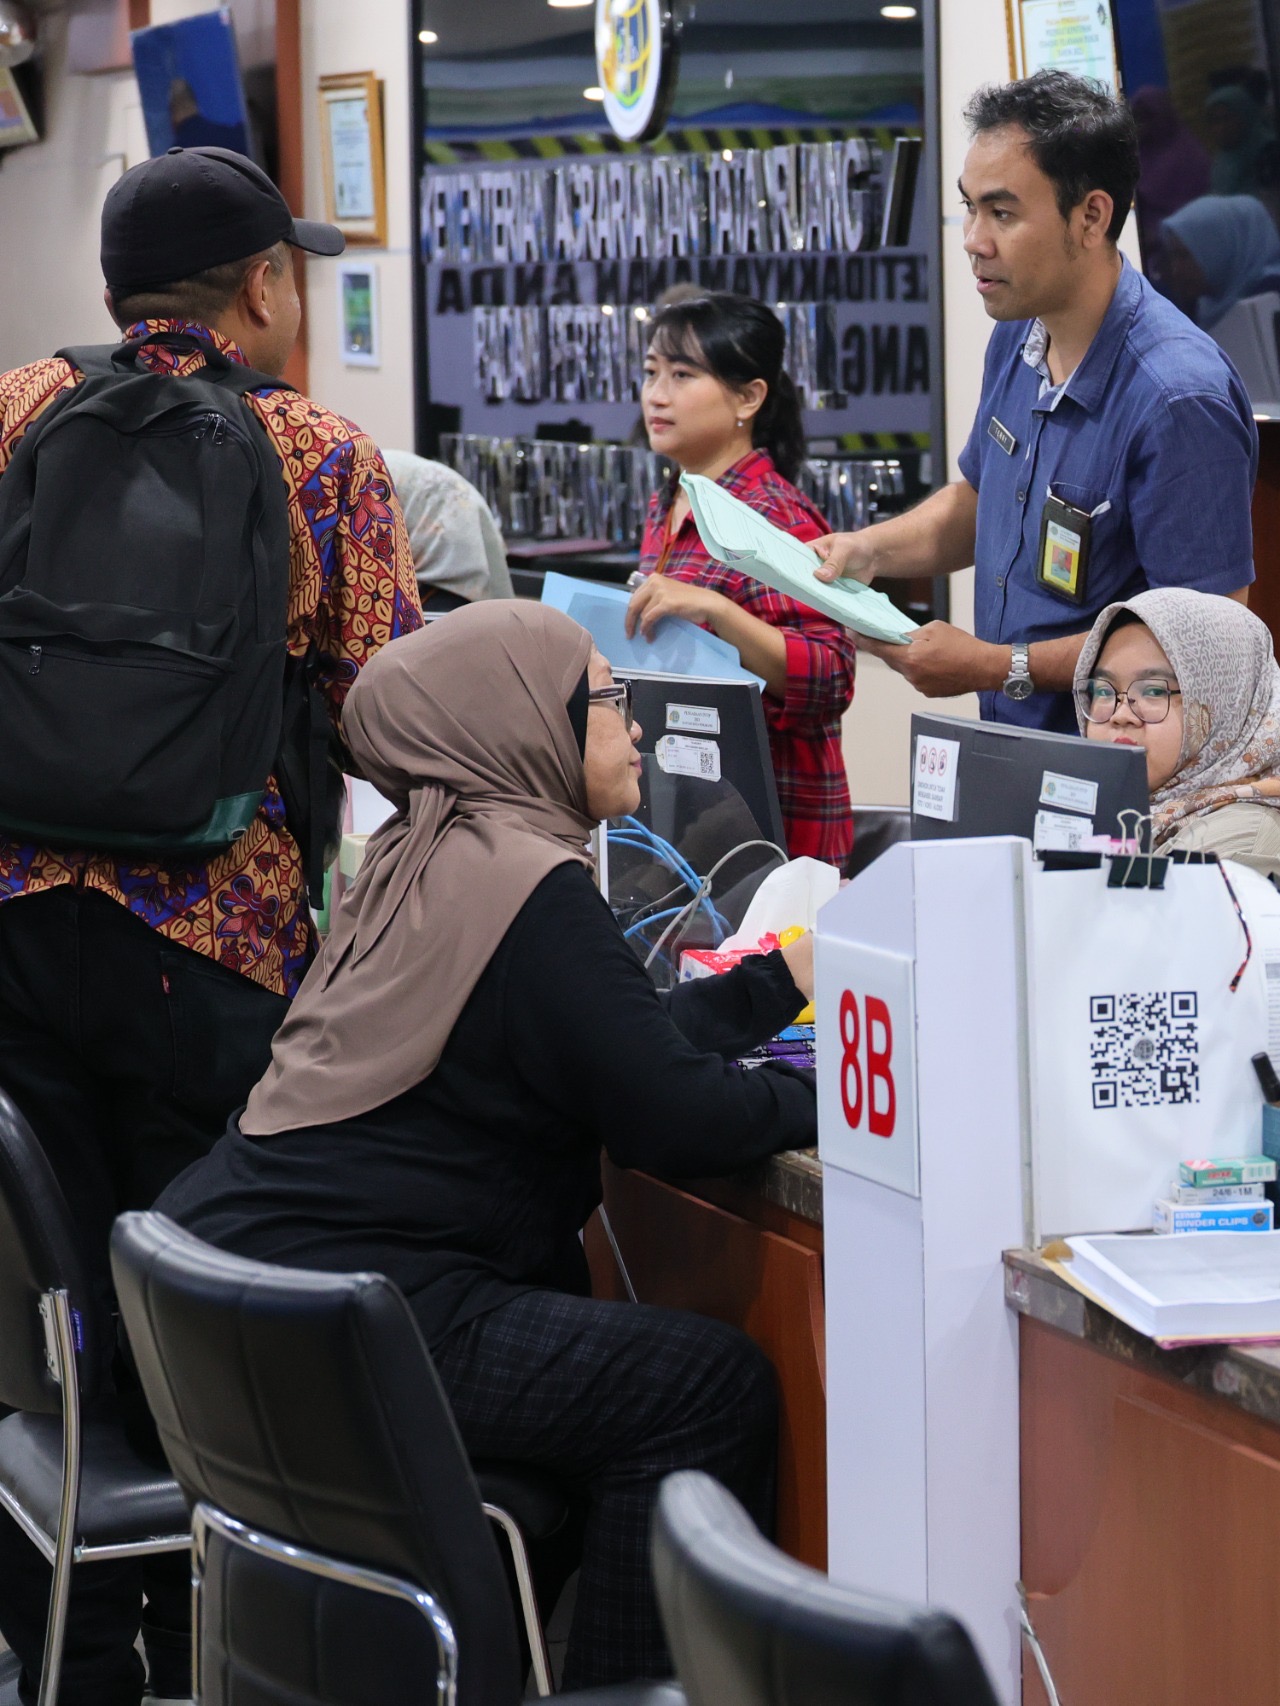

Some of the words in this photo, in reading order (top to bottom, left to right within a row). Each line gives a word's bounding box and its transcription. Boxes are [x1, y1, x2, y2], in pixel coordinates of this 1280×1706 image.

[839, 989, 896, 1138] 8B
[1175, 1218, 1216, 1228] BINDER
[1218, 1216, 1248, 1227] CLIPS
